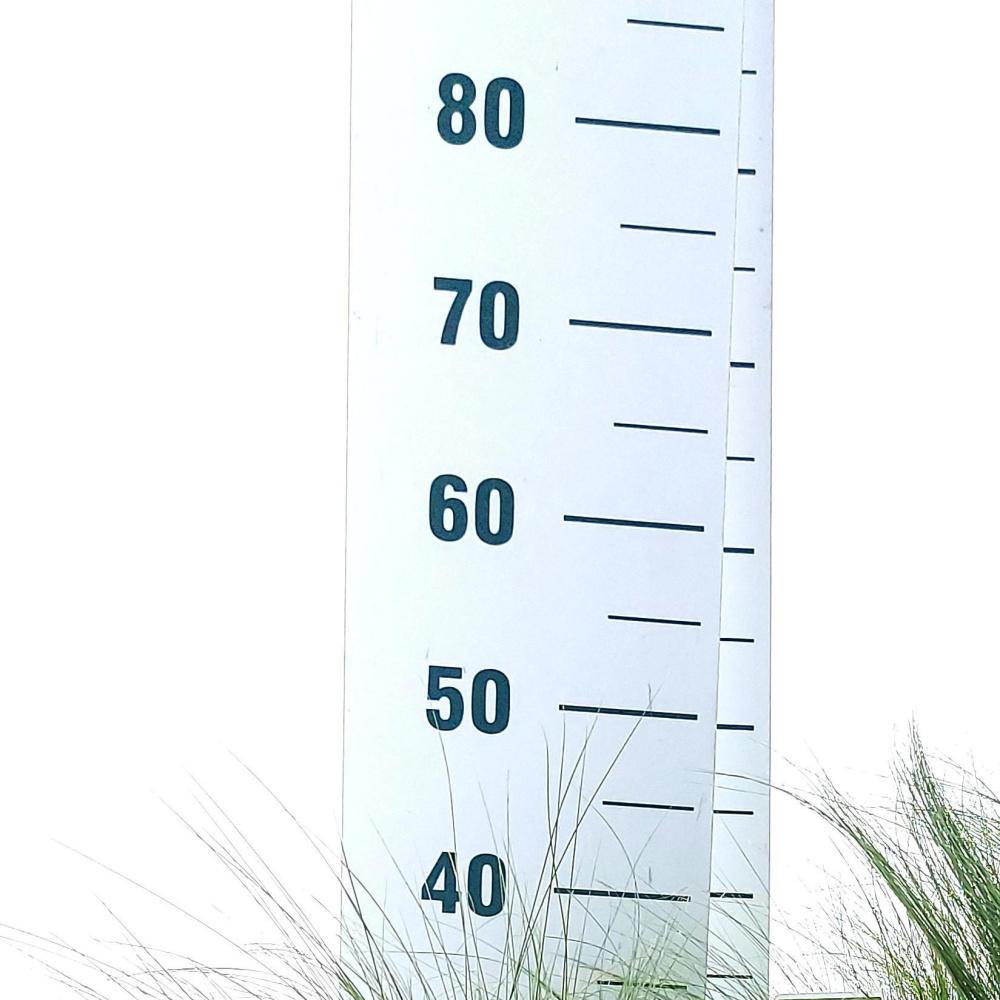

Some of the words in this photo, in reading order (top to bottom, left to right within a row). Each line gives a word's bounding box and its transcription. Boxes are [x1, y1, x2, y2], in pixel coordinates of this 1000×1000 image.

[437, 72, 525, 150] 80
[433, 276, 520, 351] 70
[428, 474, 515, 546] 60
[425, 665, 511, 735] 50
[421, 851, 507, 918] 40
